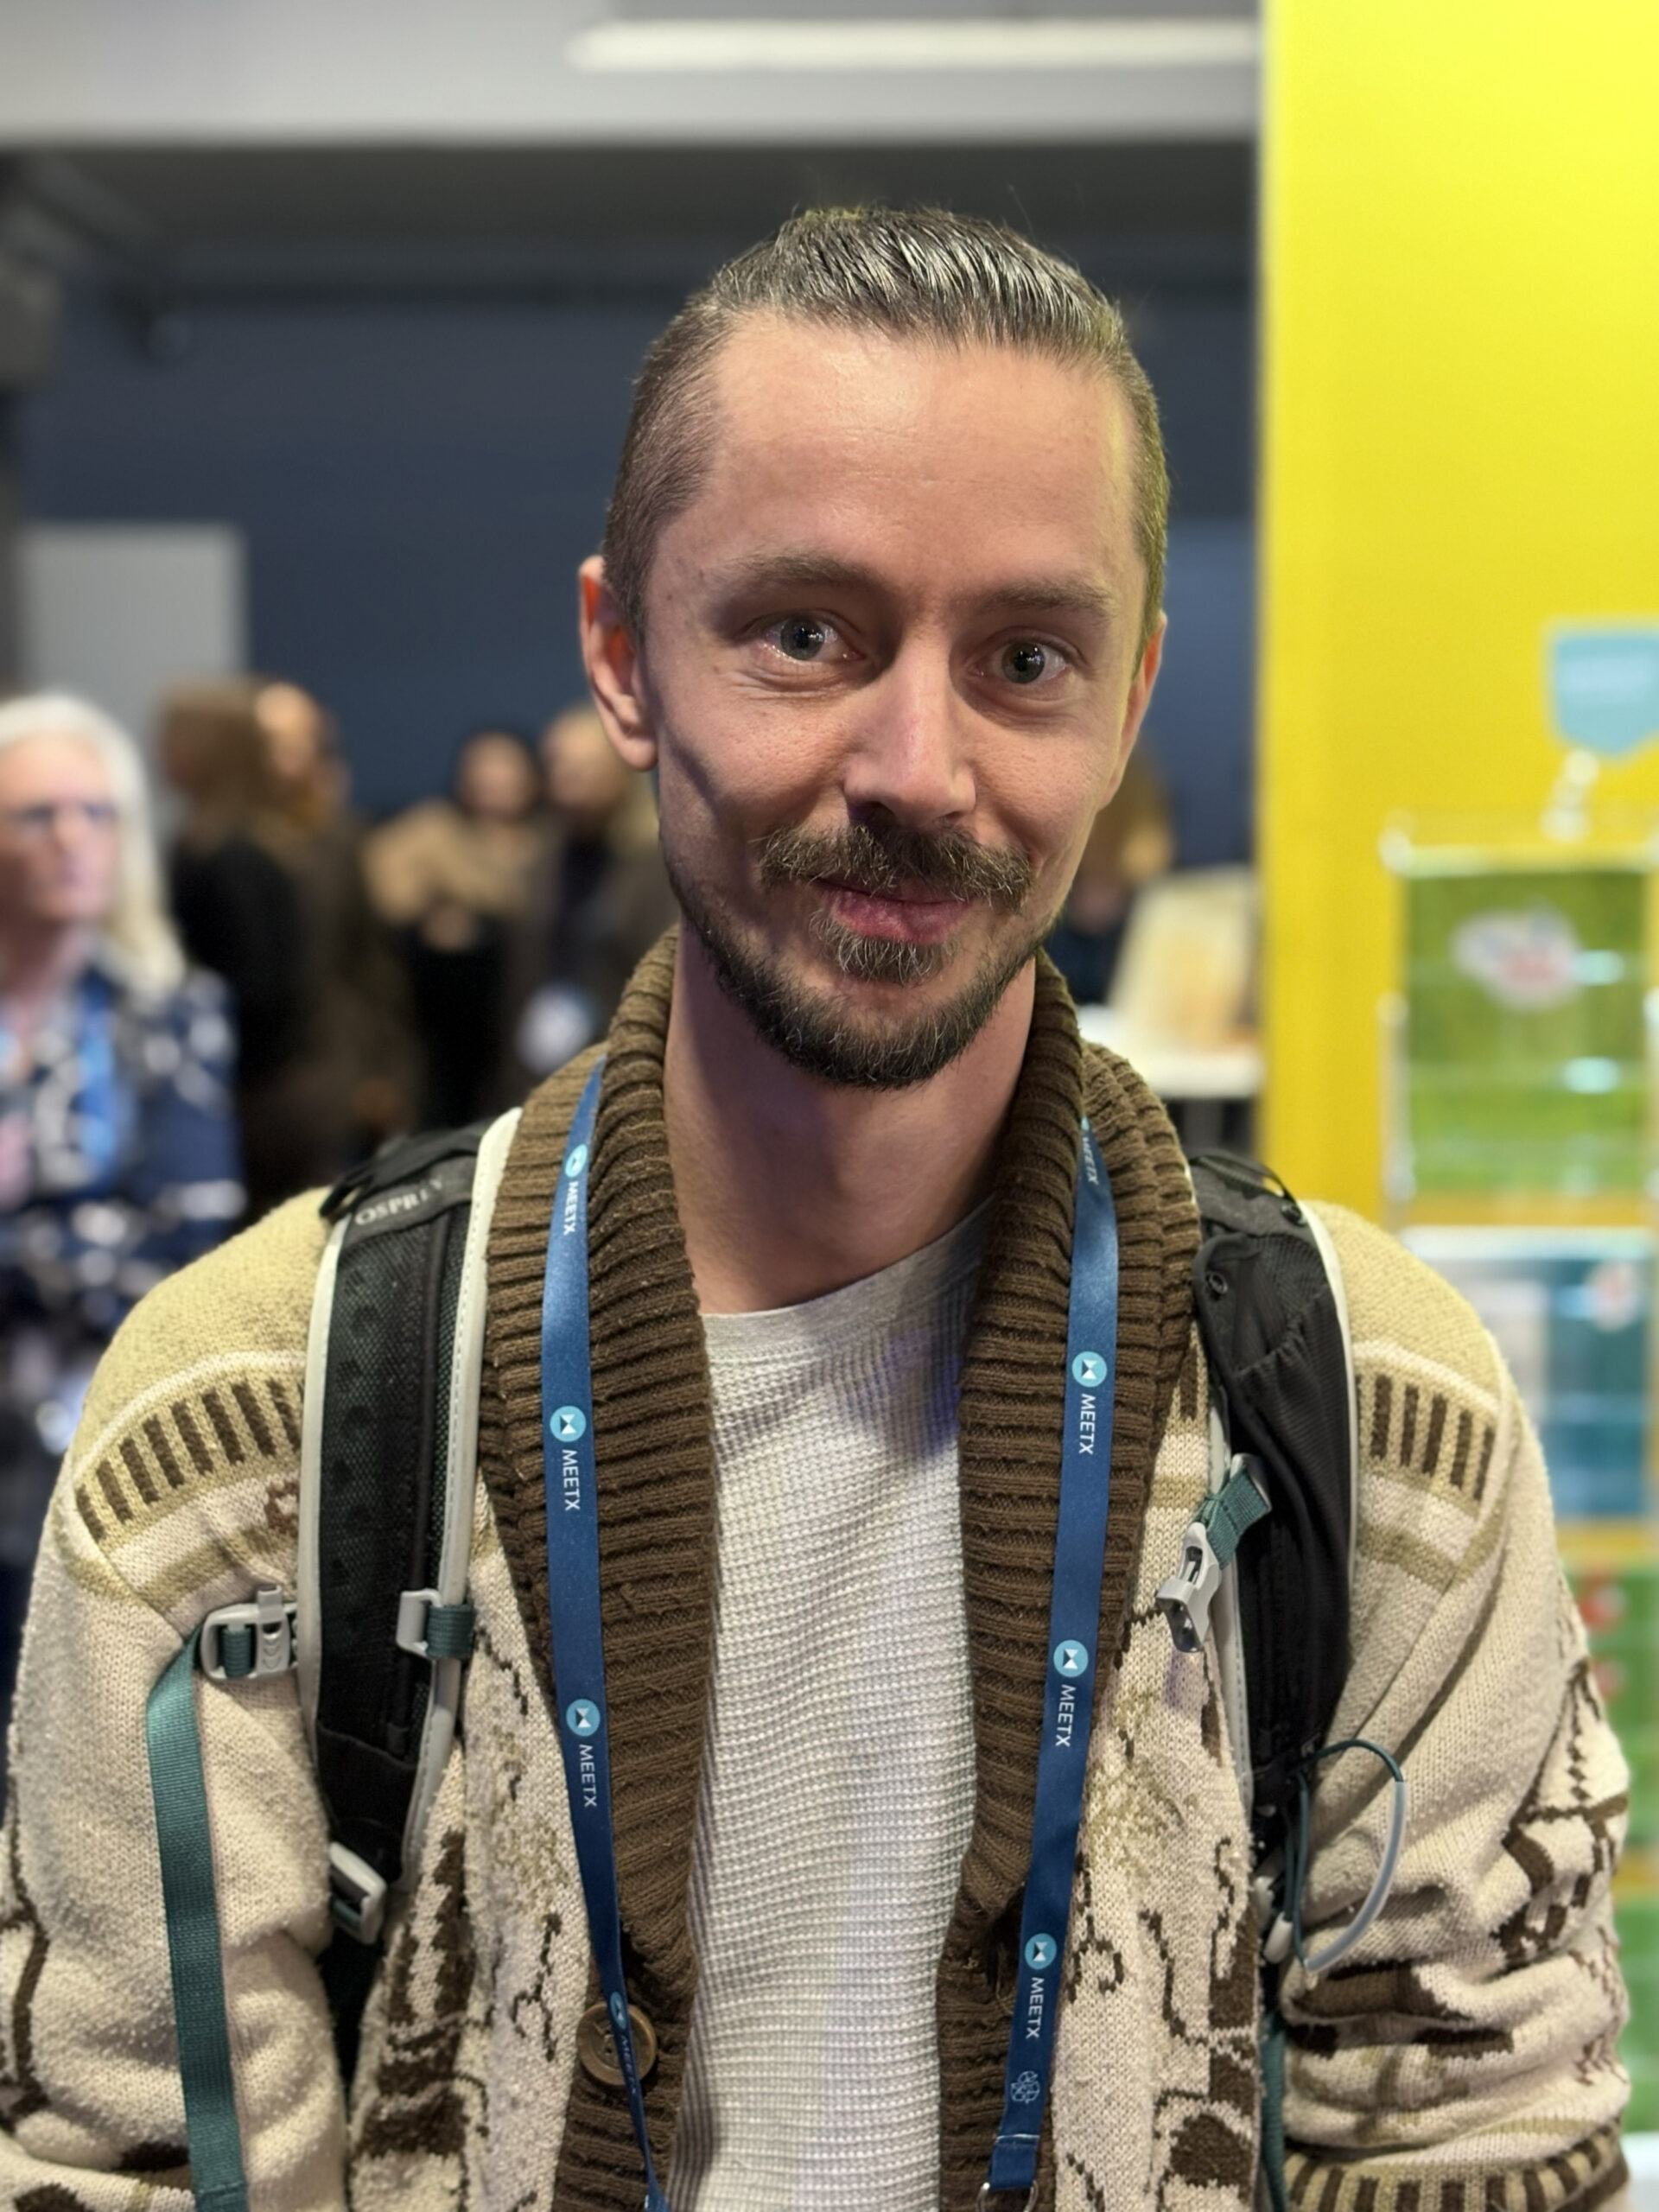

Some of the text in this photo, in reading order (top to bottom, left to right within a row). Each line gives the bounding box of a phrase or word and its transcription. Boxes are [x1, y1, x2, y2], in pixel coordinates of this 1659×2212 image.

[1082, 1136, 1098, 1185] MEETX
[563, 1180, 578, 1236] MEETX
[1079, 1393, 1096, 1455] MEETX
[562, 1449, 581, 1511] MEETX
[1055, 1683, 1076, 1747] MEETX
[579, 1744, 597, 1808] MEETX
[1026, 1976, 1044, 2038] MEETX
